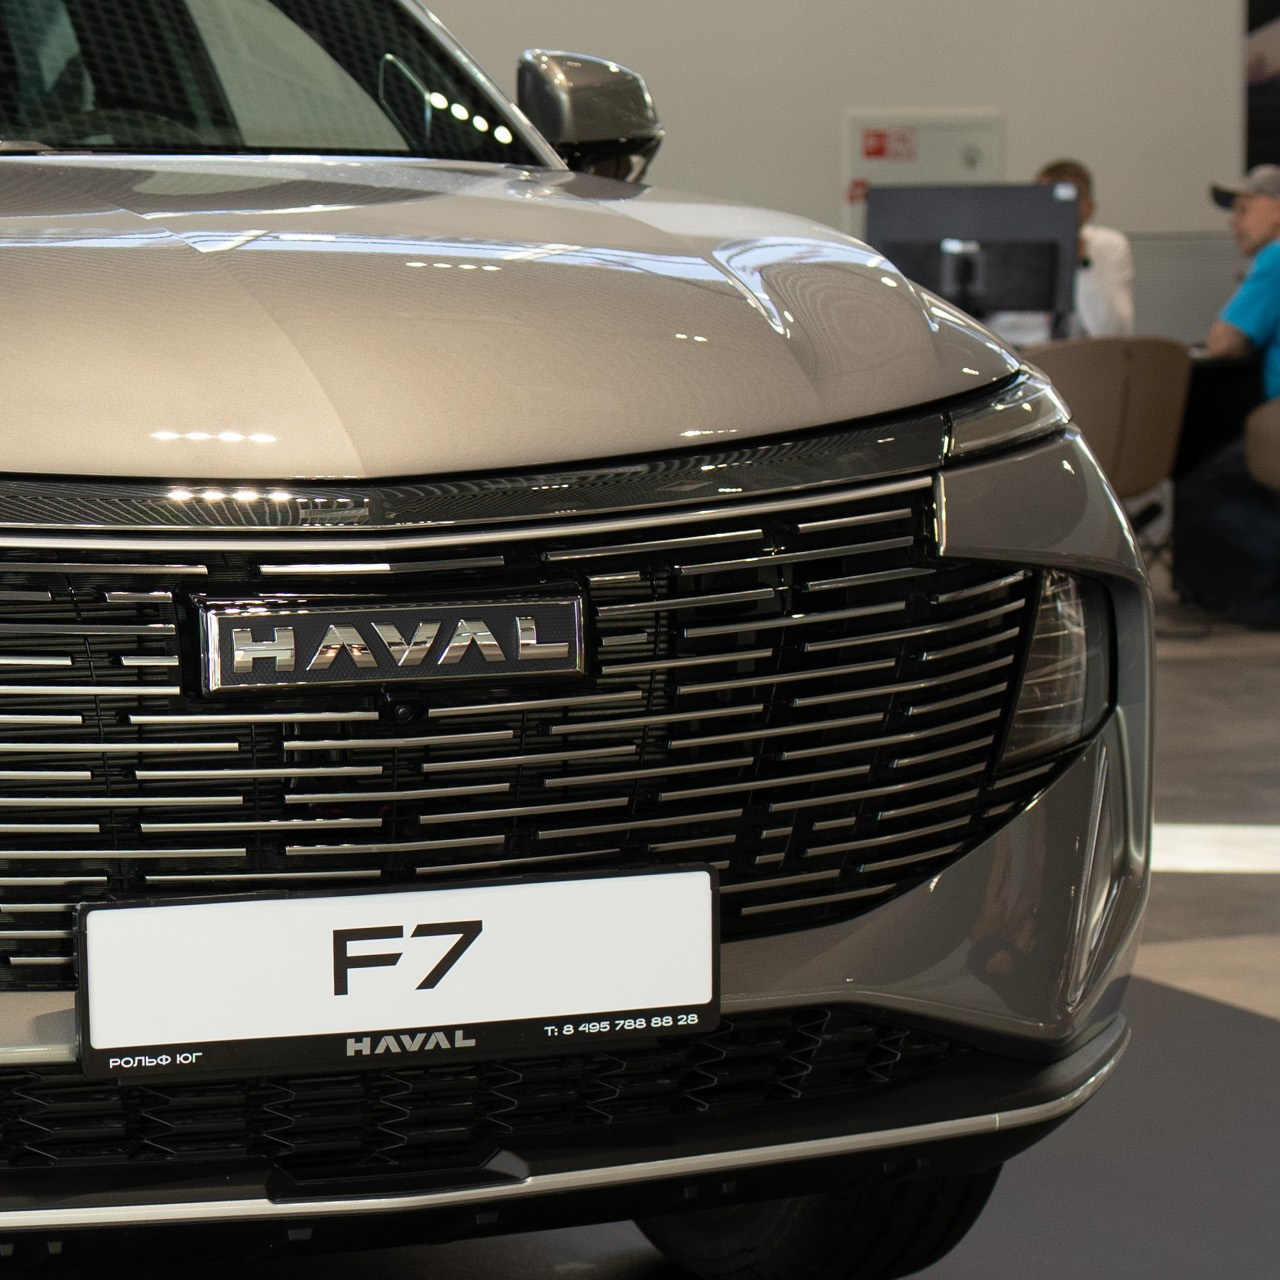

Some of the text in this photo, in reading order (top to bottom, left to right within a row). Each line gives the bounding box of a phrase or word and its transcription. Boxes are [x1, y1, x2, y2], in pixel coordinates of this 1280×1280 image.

[232, 616, 569, 673] HAVAL
[332, 919, 483, 996] F7
[562, 1024, 575, 1035] 8
[578, 1021, 611, 1033] 495
[615, 1018, 647, 1031] 788
[650, 1016, 674, 1028] 88
[677, 1013, 699, 1025] 28
[346, 1029, 476, 1056] HAVAL
[109, 1052, 203, 1069] РОЛЬФ ЮГ
